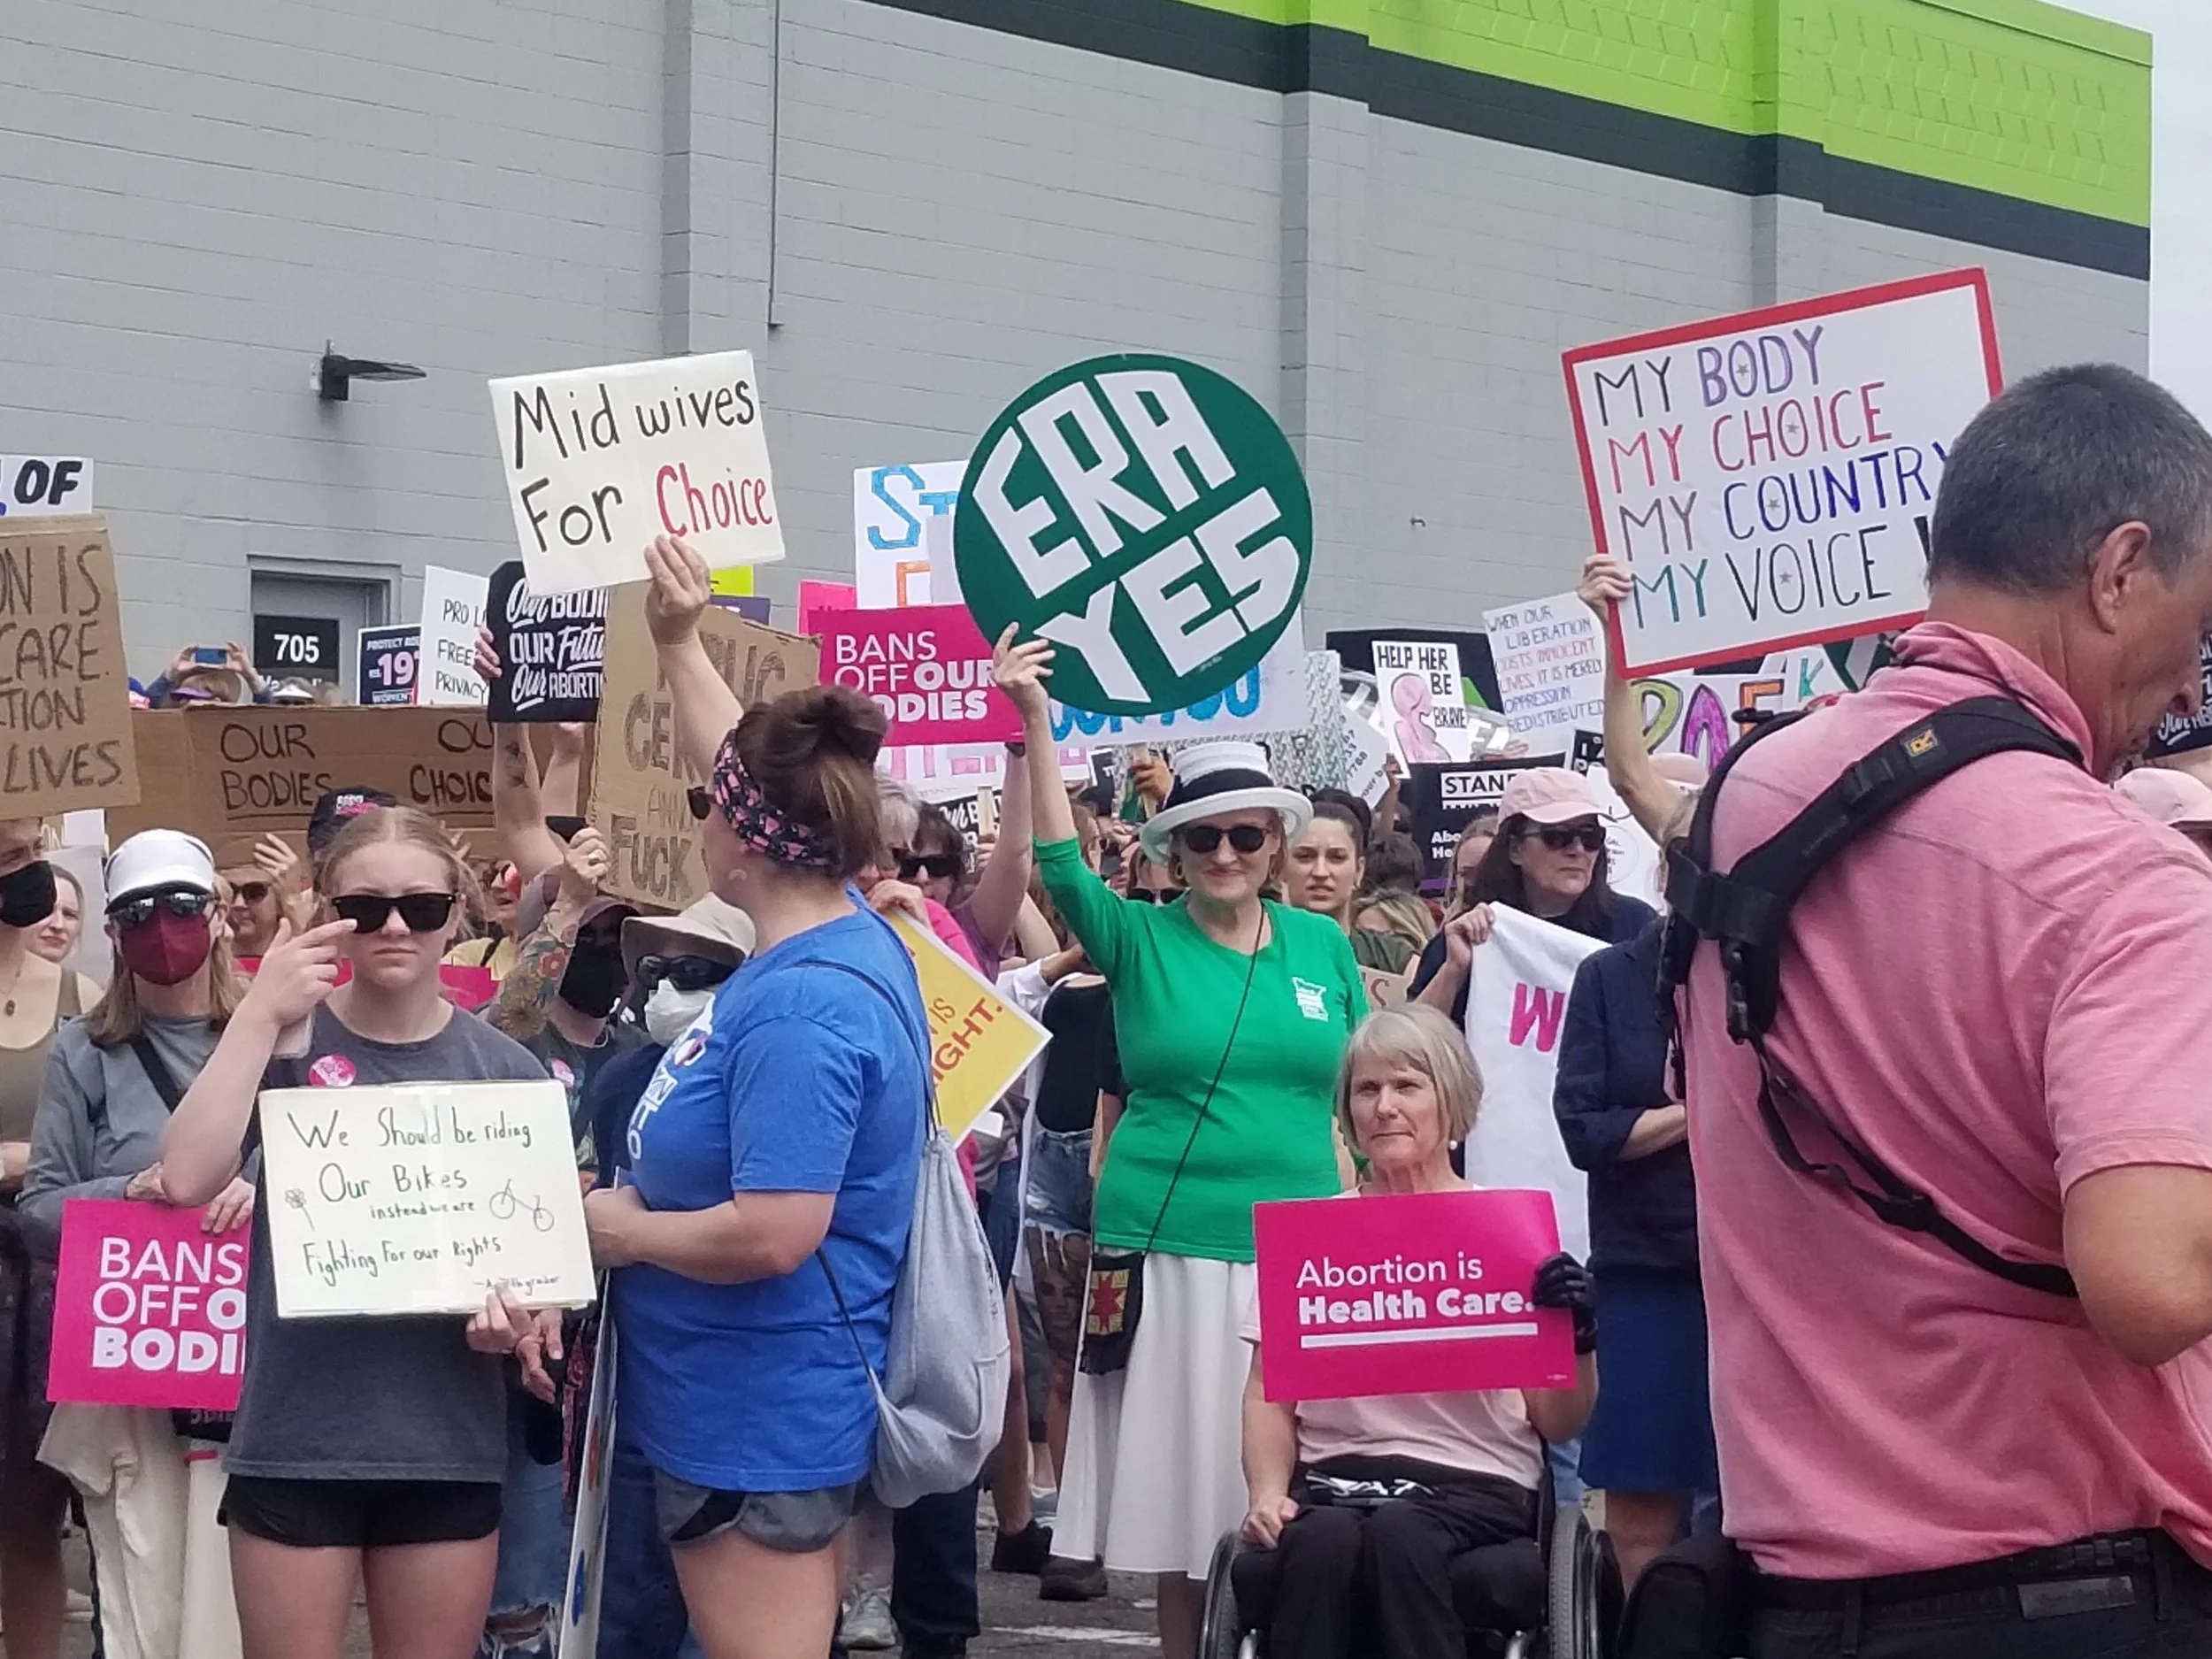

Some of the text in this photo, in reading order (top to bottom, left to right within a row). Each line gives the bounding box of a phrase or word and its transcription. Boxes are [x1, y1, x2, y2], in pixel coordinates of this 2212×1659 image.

[1594, 325, 1824, 426] MY BODY
[1608, 381, 1893, 495] MY CHOICE
[13, 459, 83, 505] OF
[972, 370, 1237, 600] ERA
[1619, 491, 1697, 562] MY
[1723, 442, 1948, 541] COUNTR
[520, 462, 773, 553] For Choice
[58, 543, 103, 617] IS
[1033, 486, 1301, 703] YES
[1631, 558, 1709, 629] MY
[1725, 525, 1893, 621] VOICE
[443, 599, 470, 625] PRO
[550, 588, 609, 619] BODI
[273, 634, 319, 664] 705
[509, 622, 605, 670] OUR Futu
[836, 631, 936, 664] BANS
[1505, 618, 1593, 650] LIBERATION
[834, 659, 997, 693] OFF OUR
[1377, 645, 1448, 671] HELP HER
[435, 670, 489, 704] PRIVACY
[511, 664, 603, 703] Our ABORTI
[1430, 672, 1452, 695] BE
[0, 687, 85, 731] TION
[872, 691, 988, 722] ODIES
[1433, 707, 1467, 729] BRAVE
[221, 718, 495, 763] OUR OU
[4, 740, 123, 793] LIVES.
[220, 770, 333, 810] BODIES
[410, 764, 493, 807] CHOIC
[609, 812, 693, 902] FUCK
[932, 996, 1005, 1082] IGHT.
[287, 1105, 532, 1148] We Should be riding
[319, 1163, 467, 1202] Our Bikes
[100, 1237, 243, 1286] BANS
[303, 1240, 379, 1286] Fighting
[413, 1248, 440, 1261] our
[452, 1236, 501, 1267] Rights
[1295, 1251, 1483, 1290] Abortion is
[93, 1281, 200, 1327] OFF
[1298, 1287, 1536, 1325] Health Care.
[92, 1326, 247, 1374] BODI
